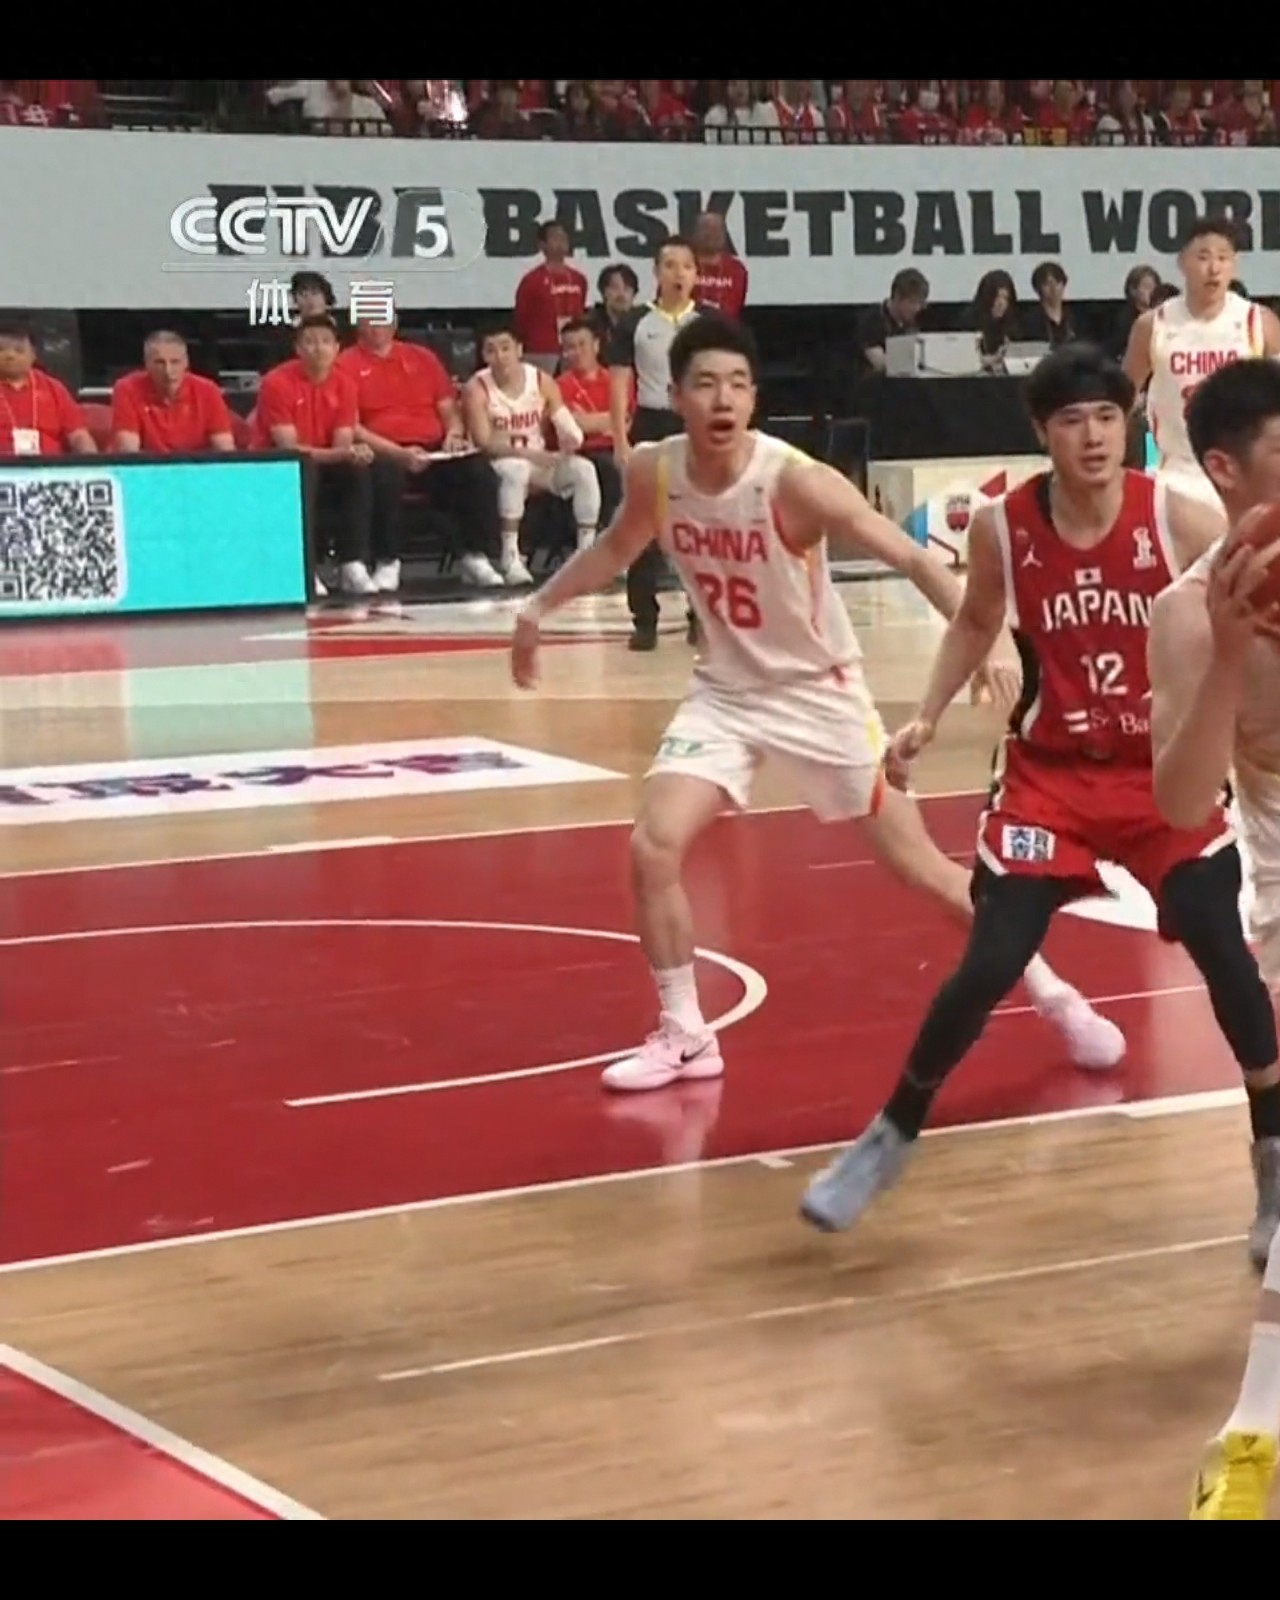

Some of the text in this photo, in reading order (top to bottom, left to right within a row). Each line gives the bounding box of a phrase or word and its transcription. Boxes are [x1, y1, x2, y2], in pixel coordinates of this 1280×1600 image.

[478, 188, 1061, 257] BASKETBALL
[672, 522, 768, 562] CHINA
[1041, 588, 1153, 632] JAPAN
[1080, 652, 1129, 695] 12
